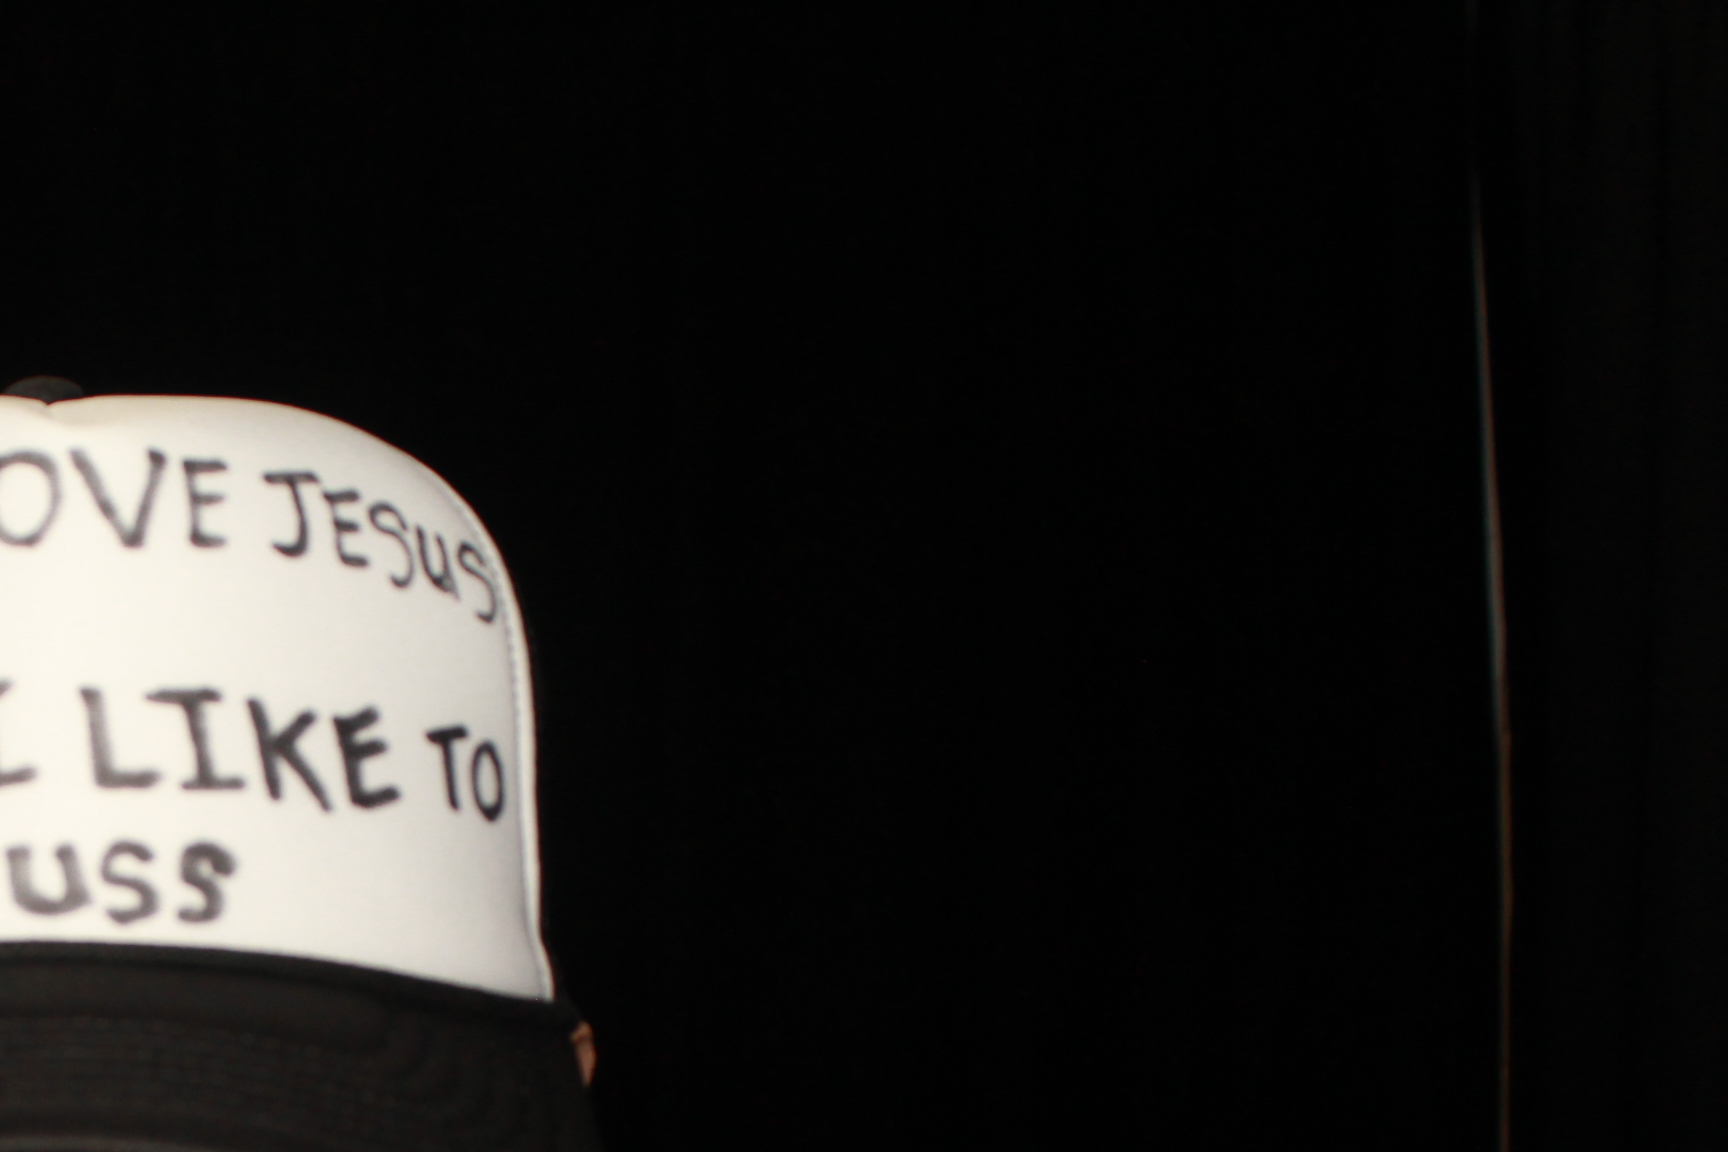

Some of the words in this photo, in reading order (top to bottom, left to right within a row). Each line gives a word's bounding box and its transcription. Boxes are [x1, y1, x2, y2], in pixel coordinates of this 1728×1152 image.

[261, 469, 500, 626] JESUS
[78, 686, 402, 813] LIKE
[424, 723, 509, 824] TO
